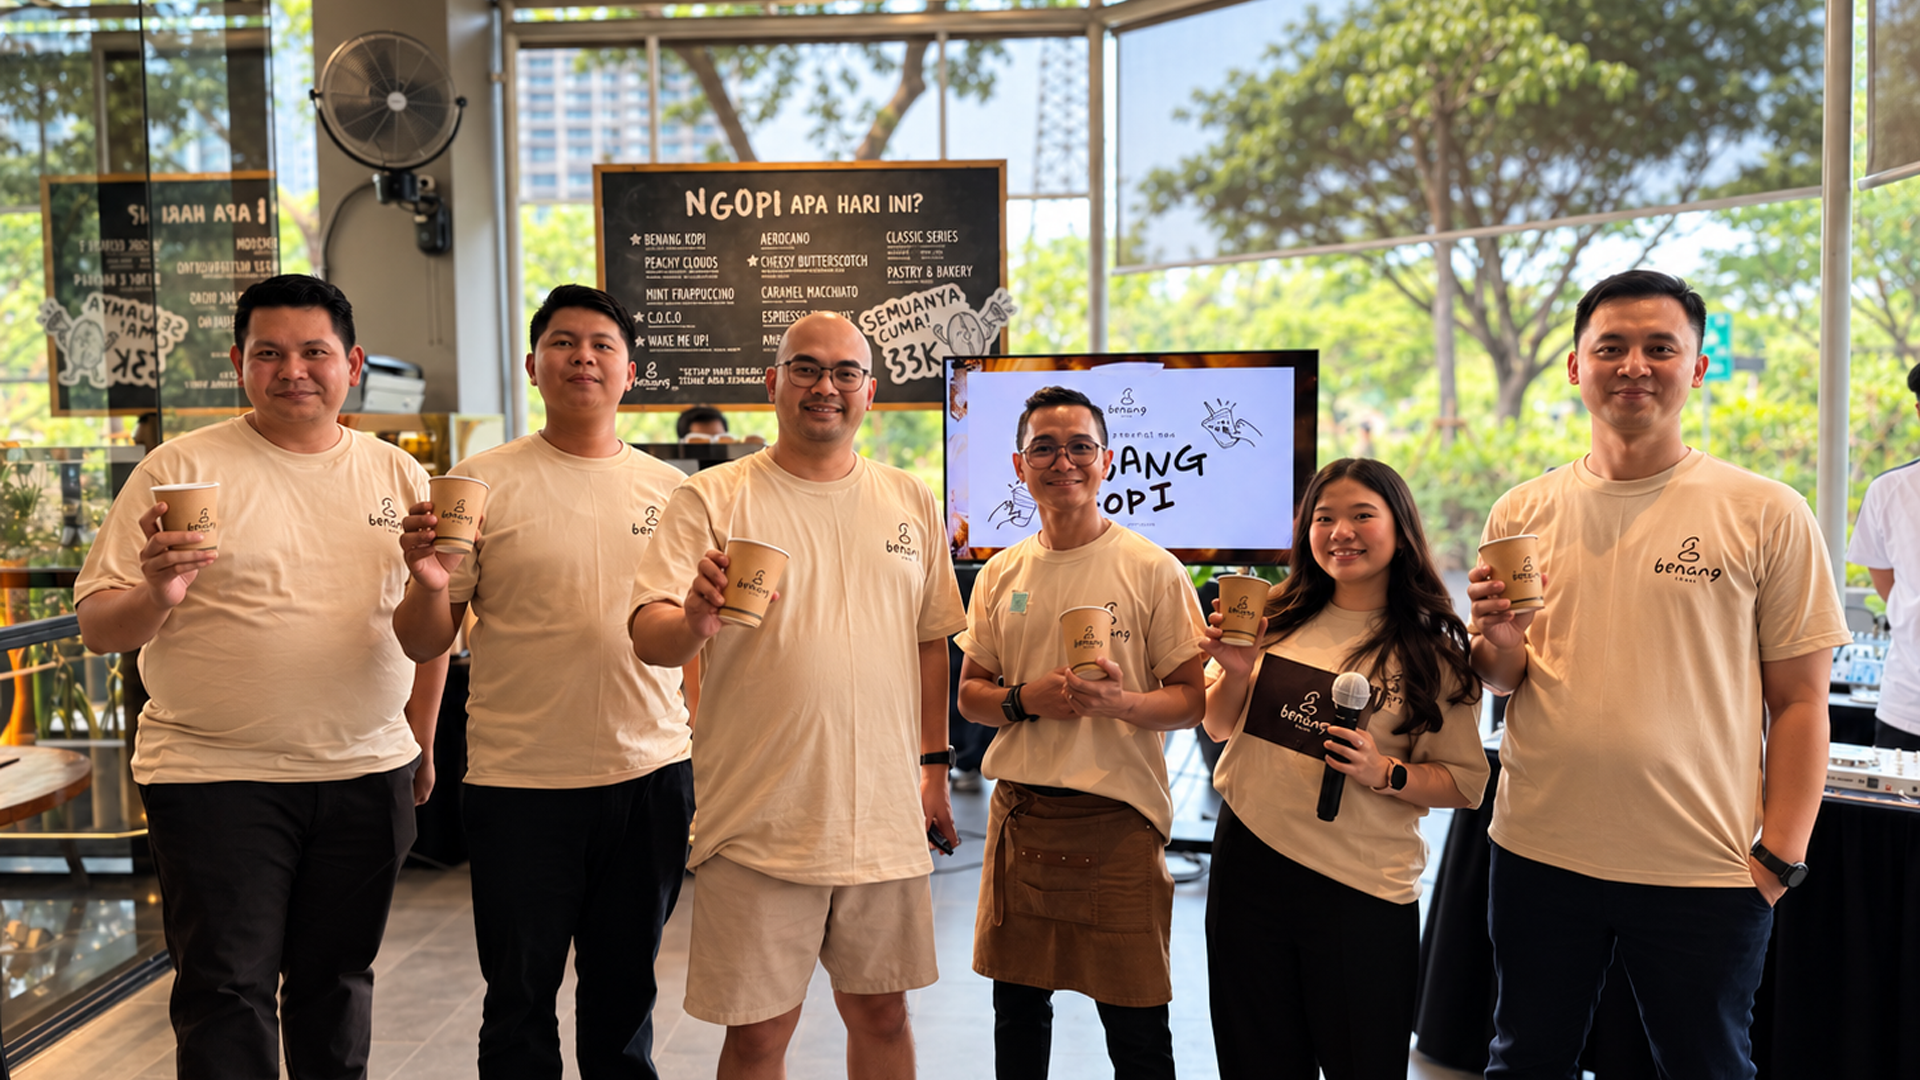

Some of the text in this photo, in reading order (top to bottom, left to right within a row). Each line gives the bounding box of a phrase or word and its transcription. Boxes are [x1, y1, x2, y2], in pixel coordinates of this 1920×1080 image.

[685, 187, 924, 221] NGOPI APA HARI INI?
[644, 232, 706, 246] BENANG KOPI
[760, 232, 810, 246] AEROCANO
[886, 230, 959, 244] CLASSIC SERIES
[645, 256, 719, 269] PEACHY CLOUDS
[760, 254, 868, 269] CHEESY BUTTERSCOTCH
[886, 266, 923, 279] PASTRY
[936, 265, 973, 278] BAKERY
[671, 287, 735, 300] FRAPPUCCINO
[761, 285, 859, 299] CARAMEL MACCHIATO
[647, 311, 682, 324] C.O.C.O
[863, 288, 961, 332] SEMUANYA
[879, 313, 931, 343] CUMA!
[648, 334, 709, 347] WAKE ME UP!
[888, 341, 942, 378] 33K
[1107, 444, 1208, 482] ANG
[1097, 481, 1175, 515] OPI
[368, 513, 404, 530] benan
[631, 522, 655, 535] ben
[1654, 557, 1722, 583] benang
[1110, 629, 1131, 644] ang
[1280, 703, 1332, 736] benang
